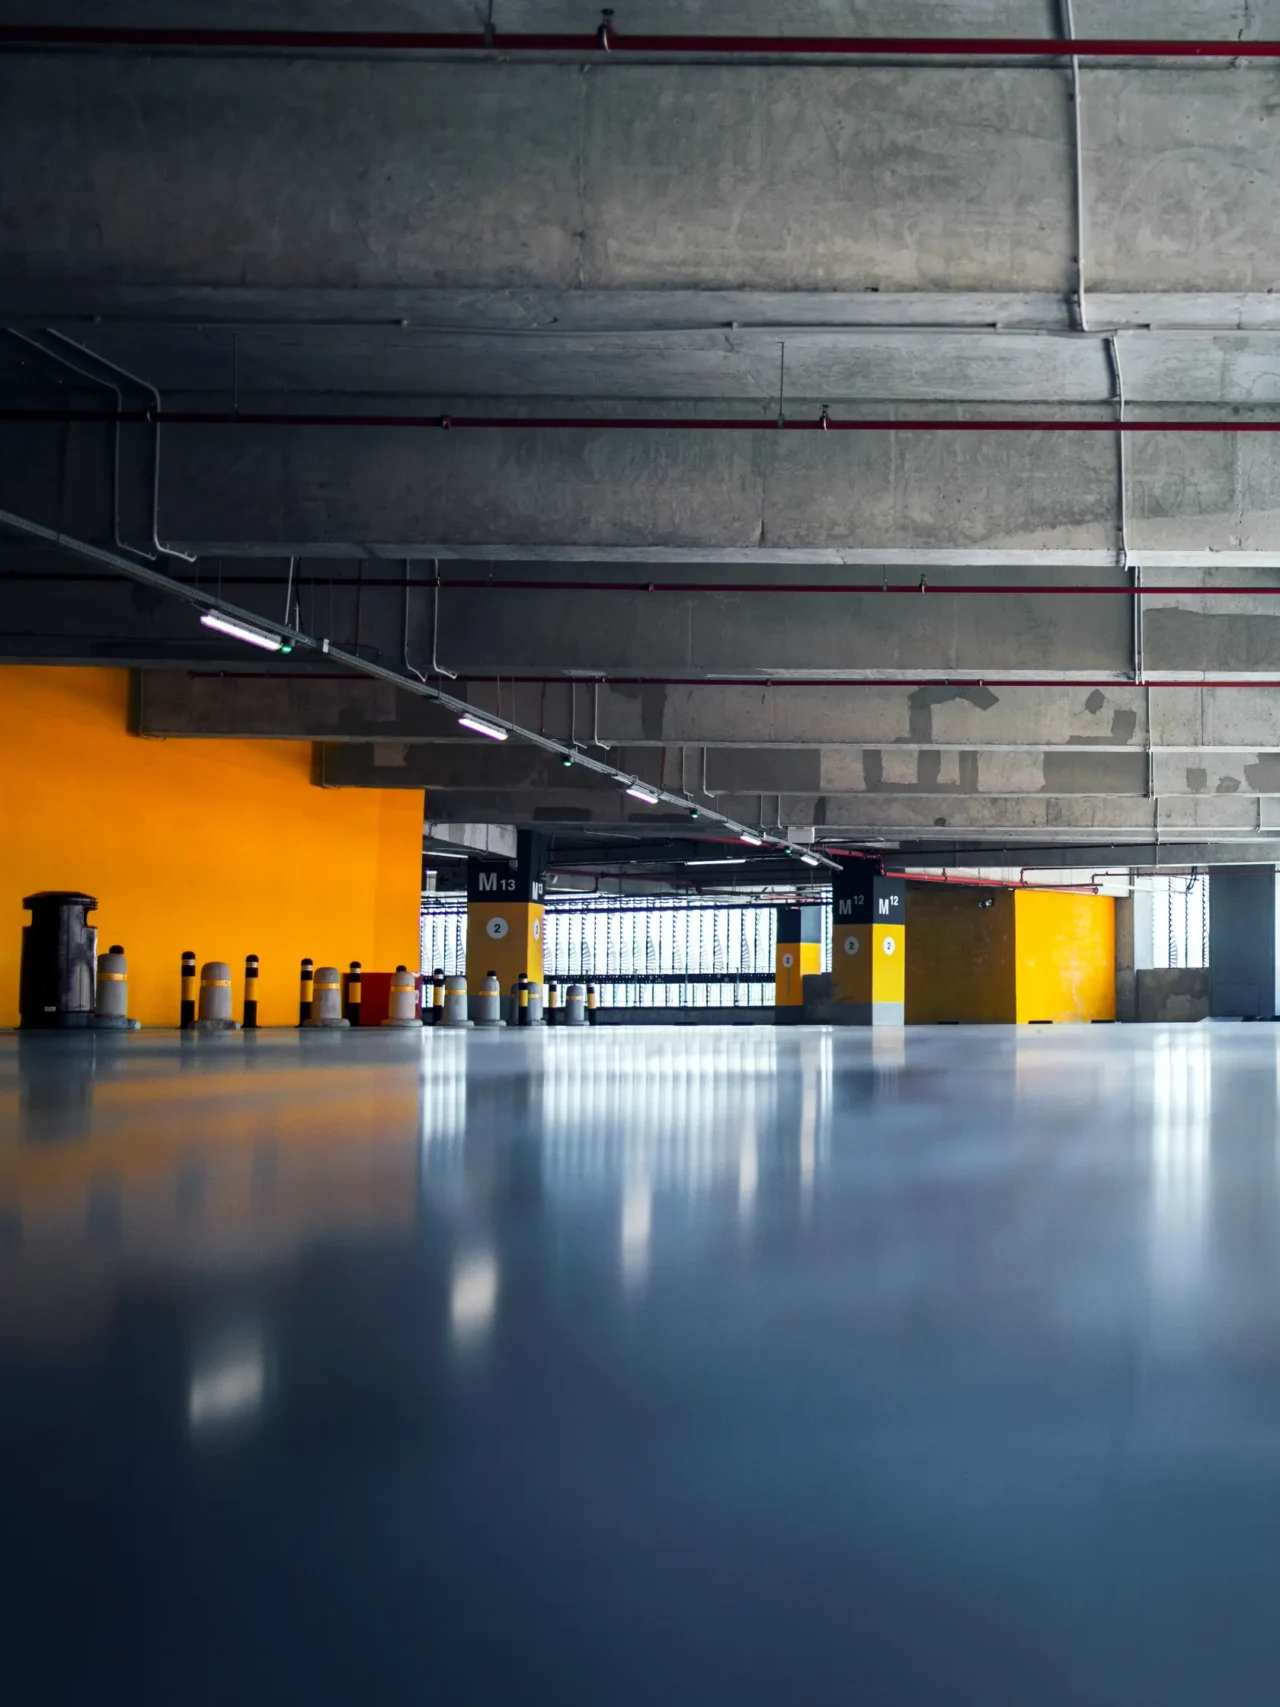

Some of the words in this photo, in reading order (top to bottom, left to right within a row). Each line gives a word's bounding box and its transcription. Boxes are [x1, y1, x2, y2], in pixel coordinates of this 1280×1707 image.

[478, 872, 498, 891] M
[500, 879, 516, 891] 13
[839, 899, 852, 915] M
[853, 895, 864, 905] 12
[878, 898, 889, 915] M
[890, 895, 899, 906] 12
[493, 923, 501, 933] 2
[849, 941, 855, 950] 2
